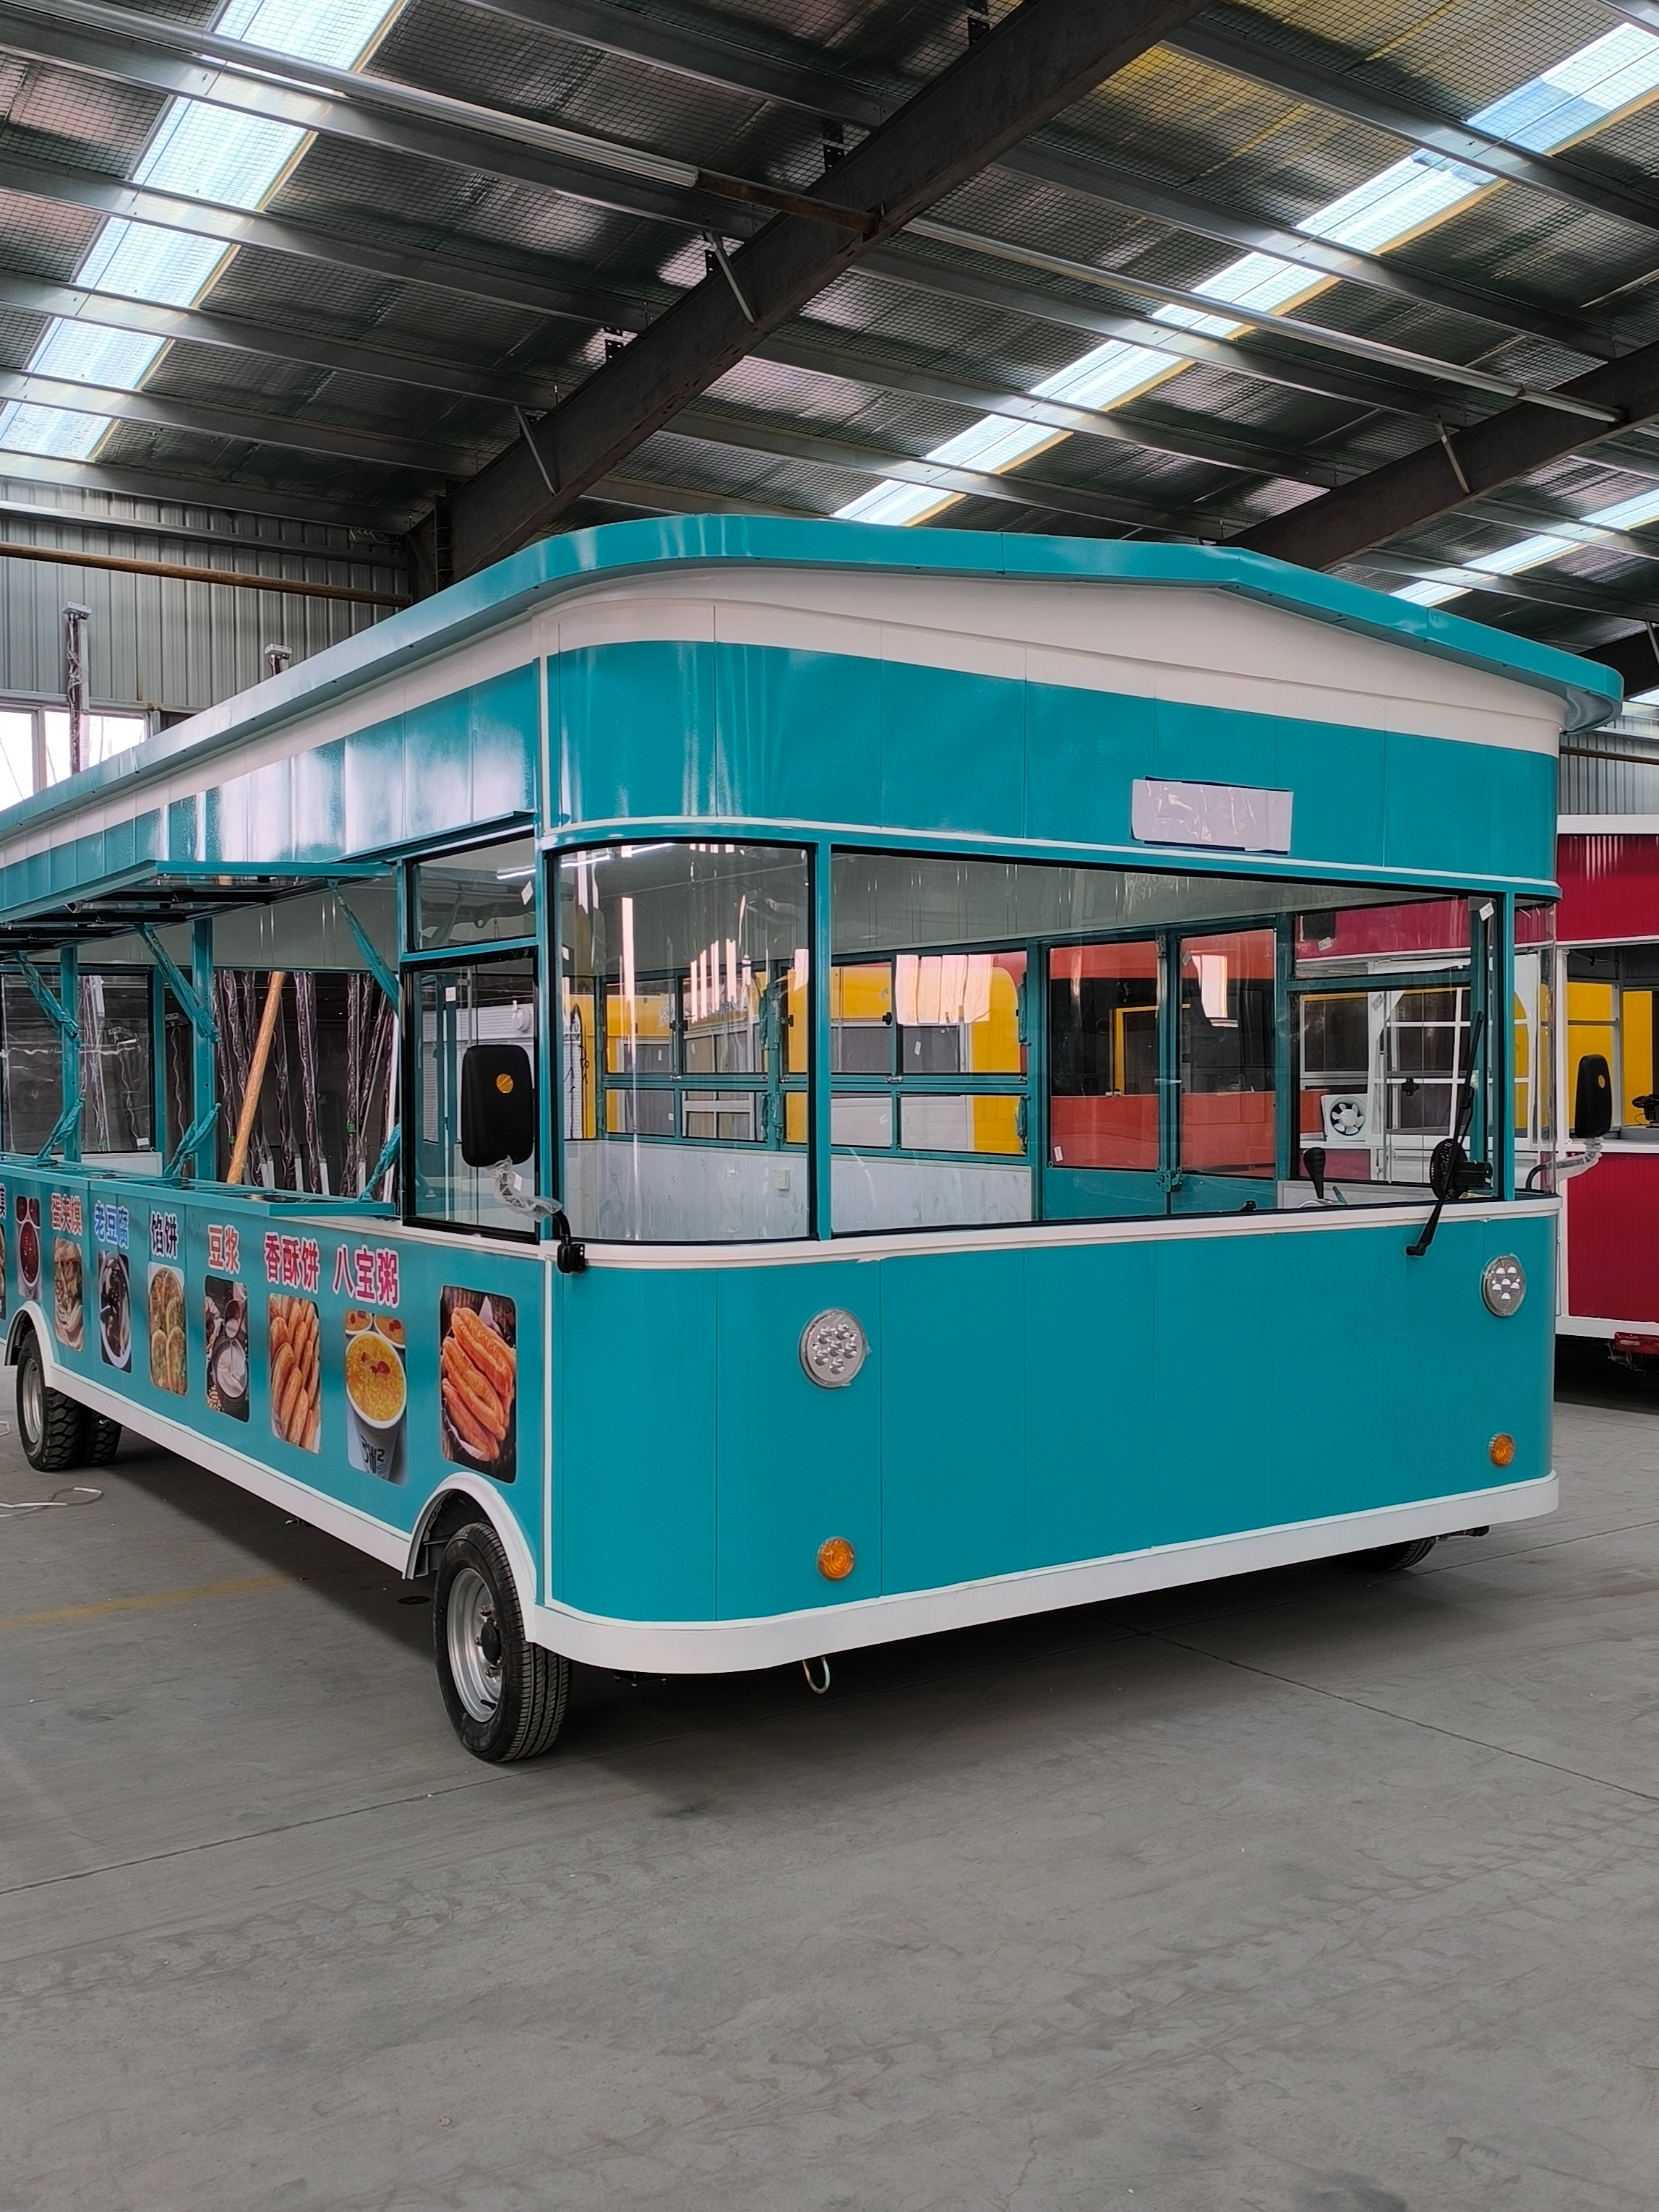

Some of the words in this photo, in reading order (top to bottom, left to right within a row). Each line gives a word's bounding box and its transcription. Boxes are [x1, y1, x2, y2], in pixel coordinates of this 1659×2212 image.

[95, 1200, 129, 1249] 老豆腐
[150, 1211, 179, 1259] 馅饼
[208, 1225, 240, 1274] 豆浆
[265, 1232, 320, 1294] 香酥饼
[333, 1244, 399, 1308] 八宝粥
